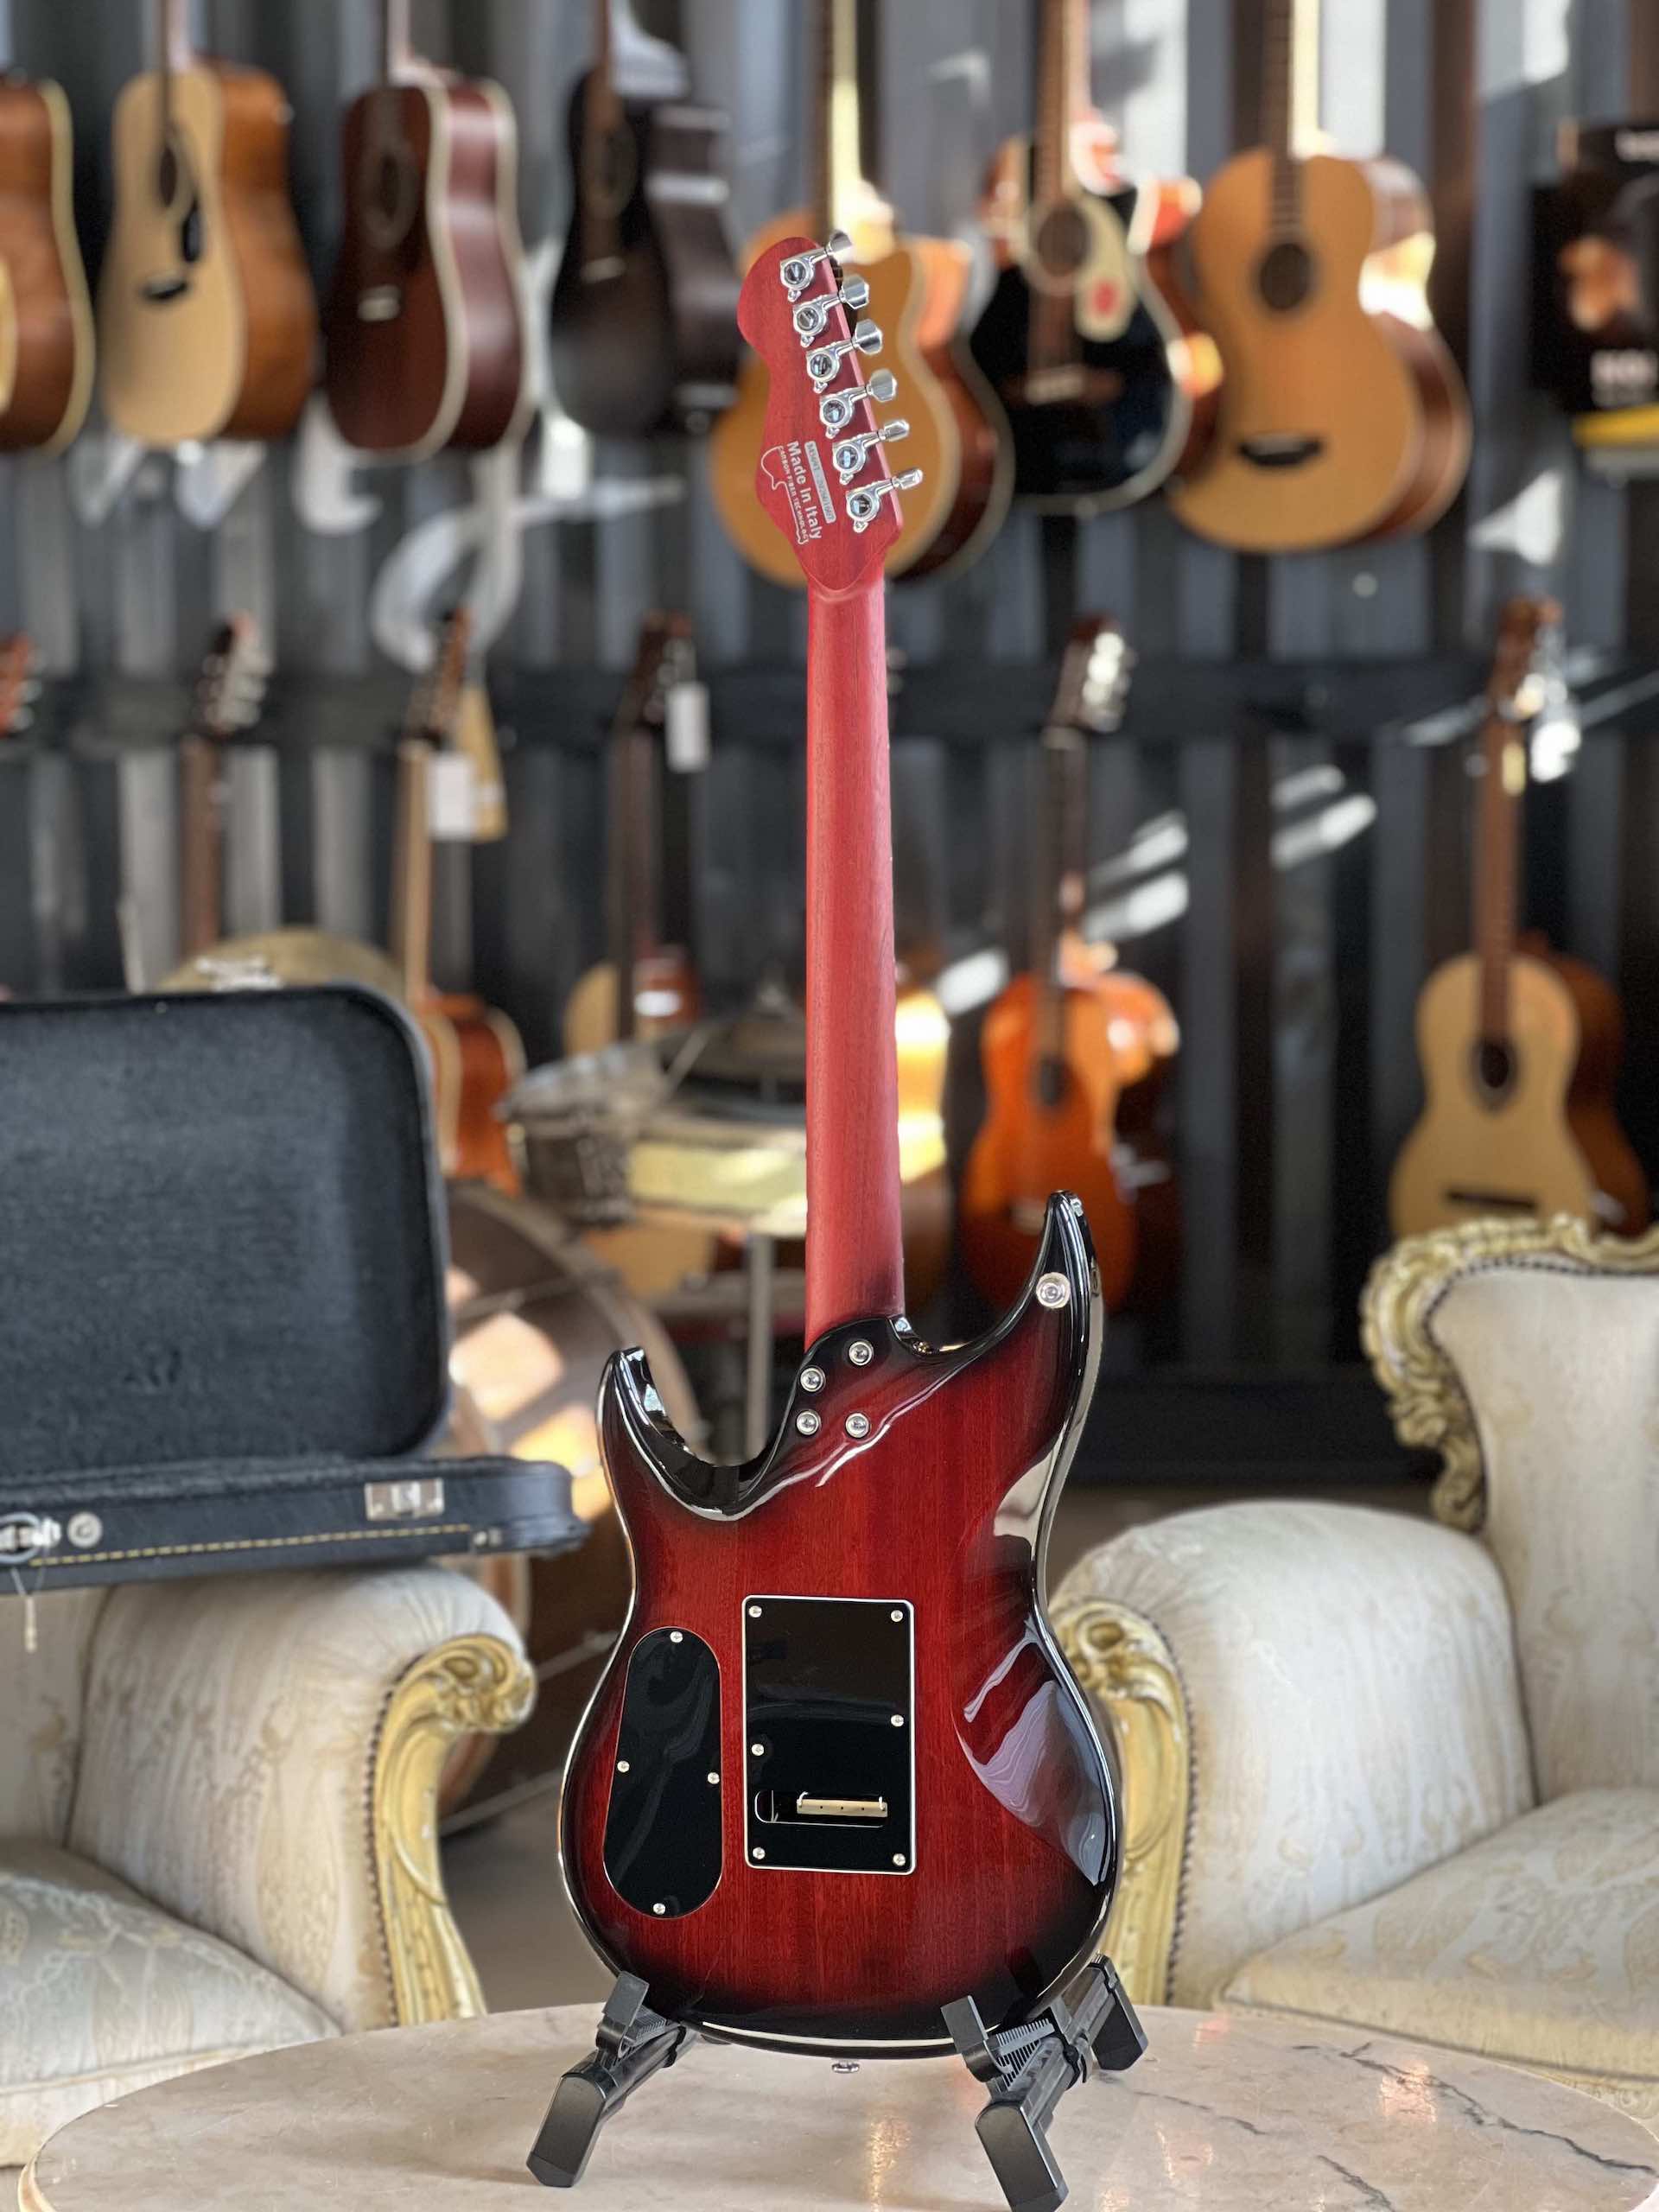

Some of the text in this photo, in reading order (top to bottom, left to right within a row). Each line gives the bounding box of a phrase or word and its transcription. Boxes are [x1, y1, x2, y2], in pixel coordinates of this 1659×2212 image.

[779, 446, 791, 474] CARBON
[787, 475, 796, 496] FIBER
[787, 441, 806, 485] Made
[804, 505, 823, 538] Italy
